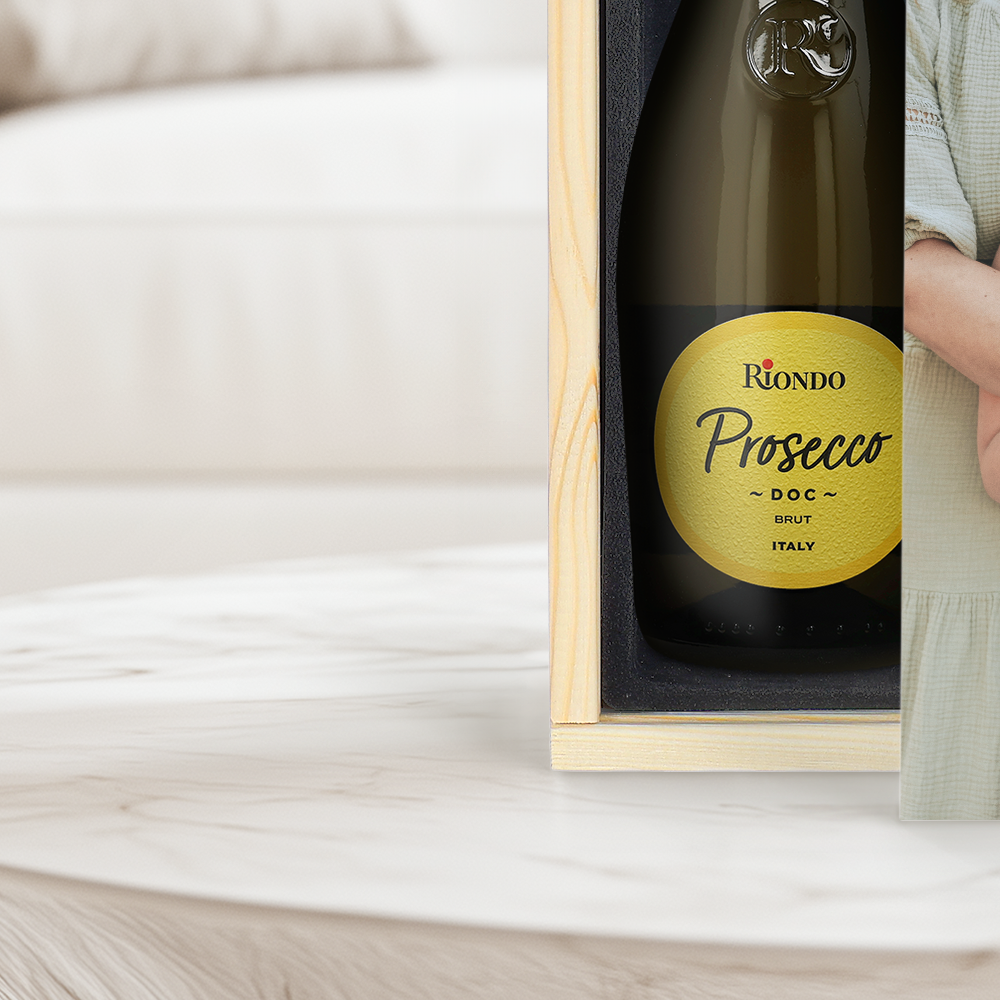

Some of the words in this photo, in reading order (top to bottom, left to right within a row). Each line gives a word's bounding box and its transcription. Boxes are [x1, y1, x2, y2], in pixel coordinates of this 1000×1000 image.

[696, 407, 893, 474] Prosecco
[775, 515, 812, 524] BRUT
[772, 542, 815, 551] ITALY
